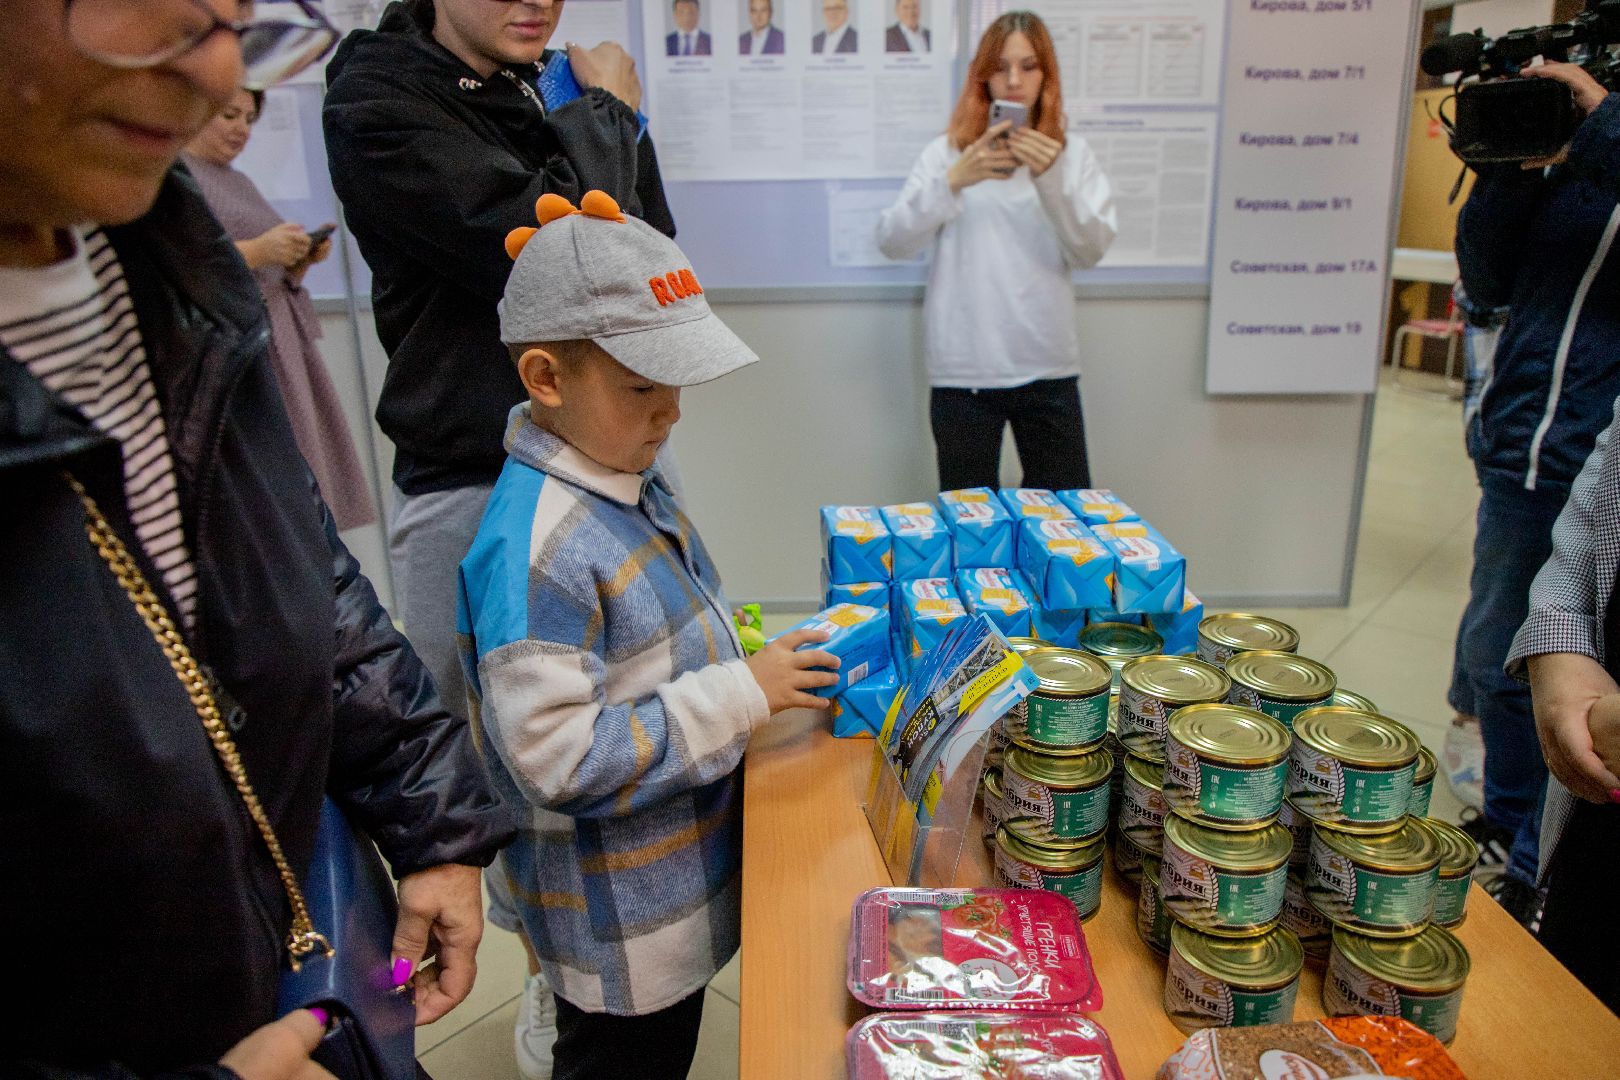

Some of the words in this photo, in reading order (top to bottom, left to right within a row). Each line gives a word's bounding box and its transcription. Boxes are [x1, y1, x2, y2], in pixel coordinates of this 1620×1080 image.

[1314, 0, 1346, 12] дом
[1308, 69, 1340, 80] дом
[1302, 135, 1334, 147] дом
[1297, 201, 1328, 211] дом
[1315, 263, 1346, 274] дом
[1311, 325, 1341, 336] дом
[1119, 702, 1155, 729] брия
[1289, 759, 1331, 789] брия
[1035, 921, 1062, 968] ГРЕНКИ
